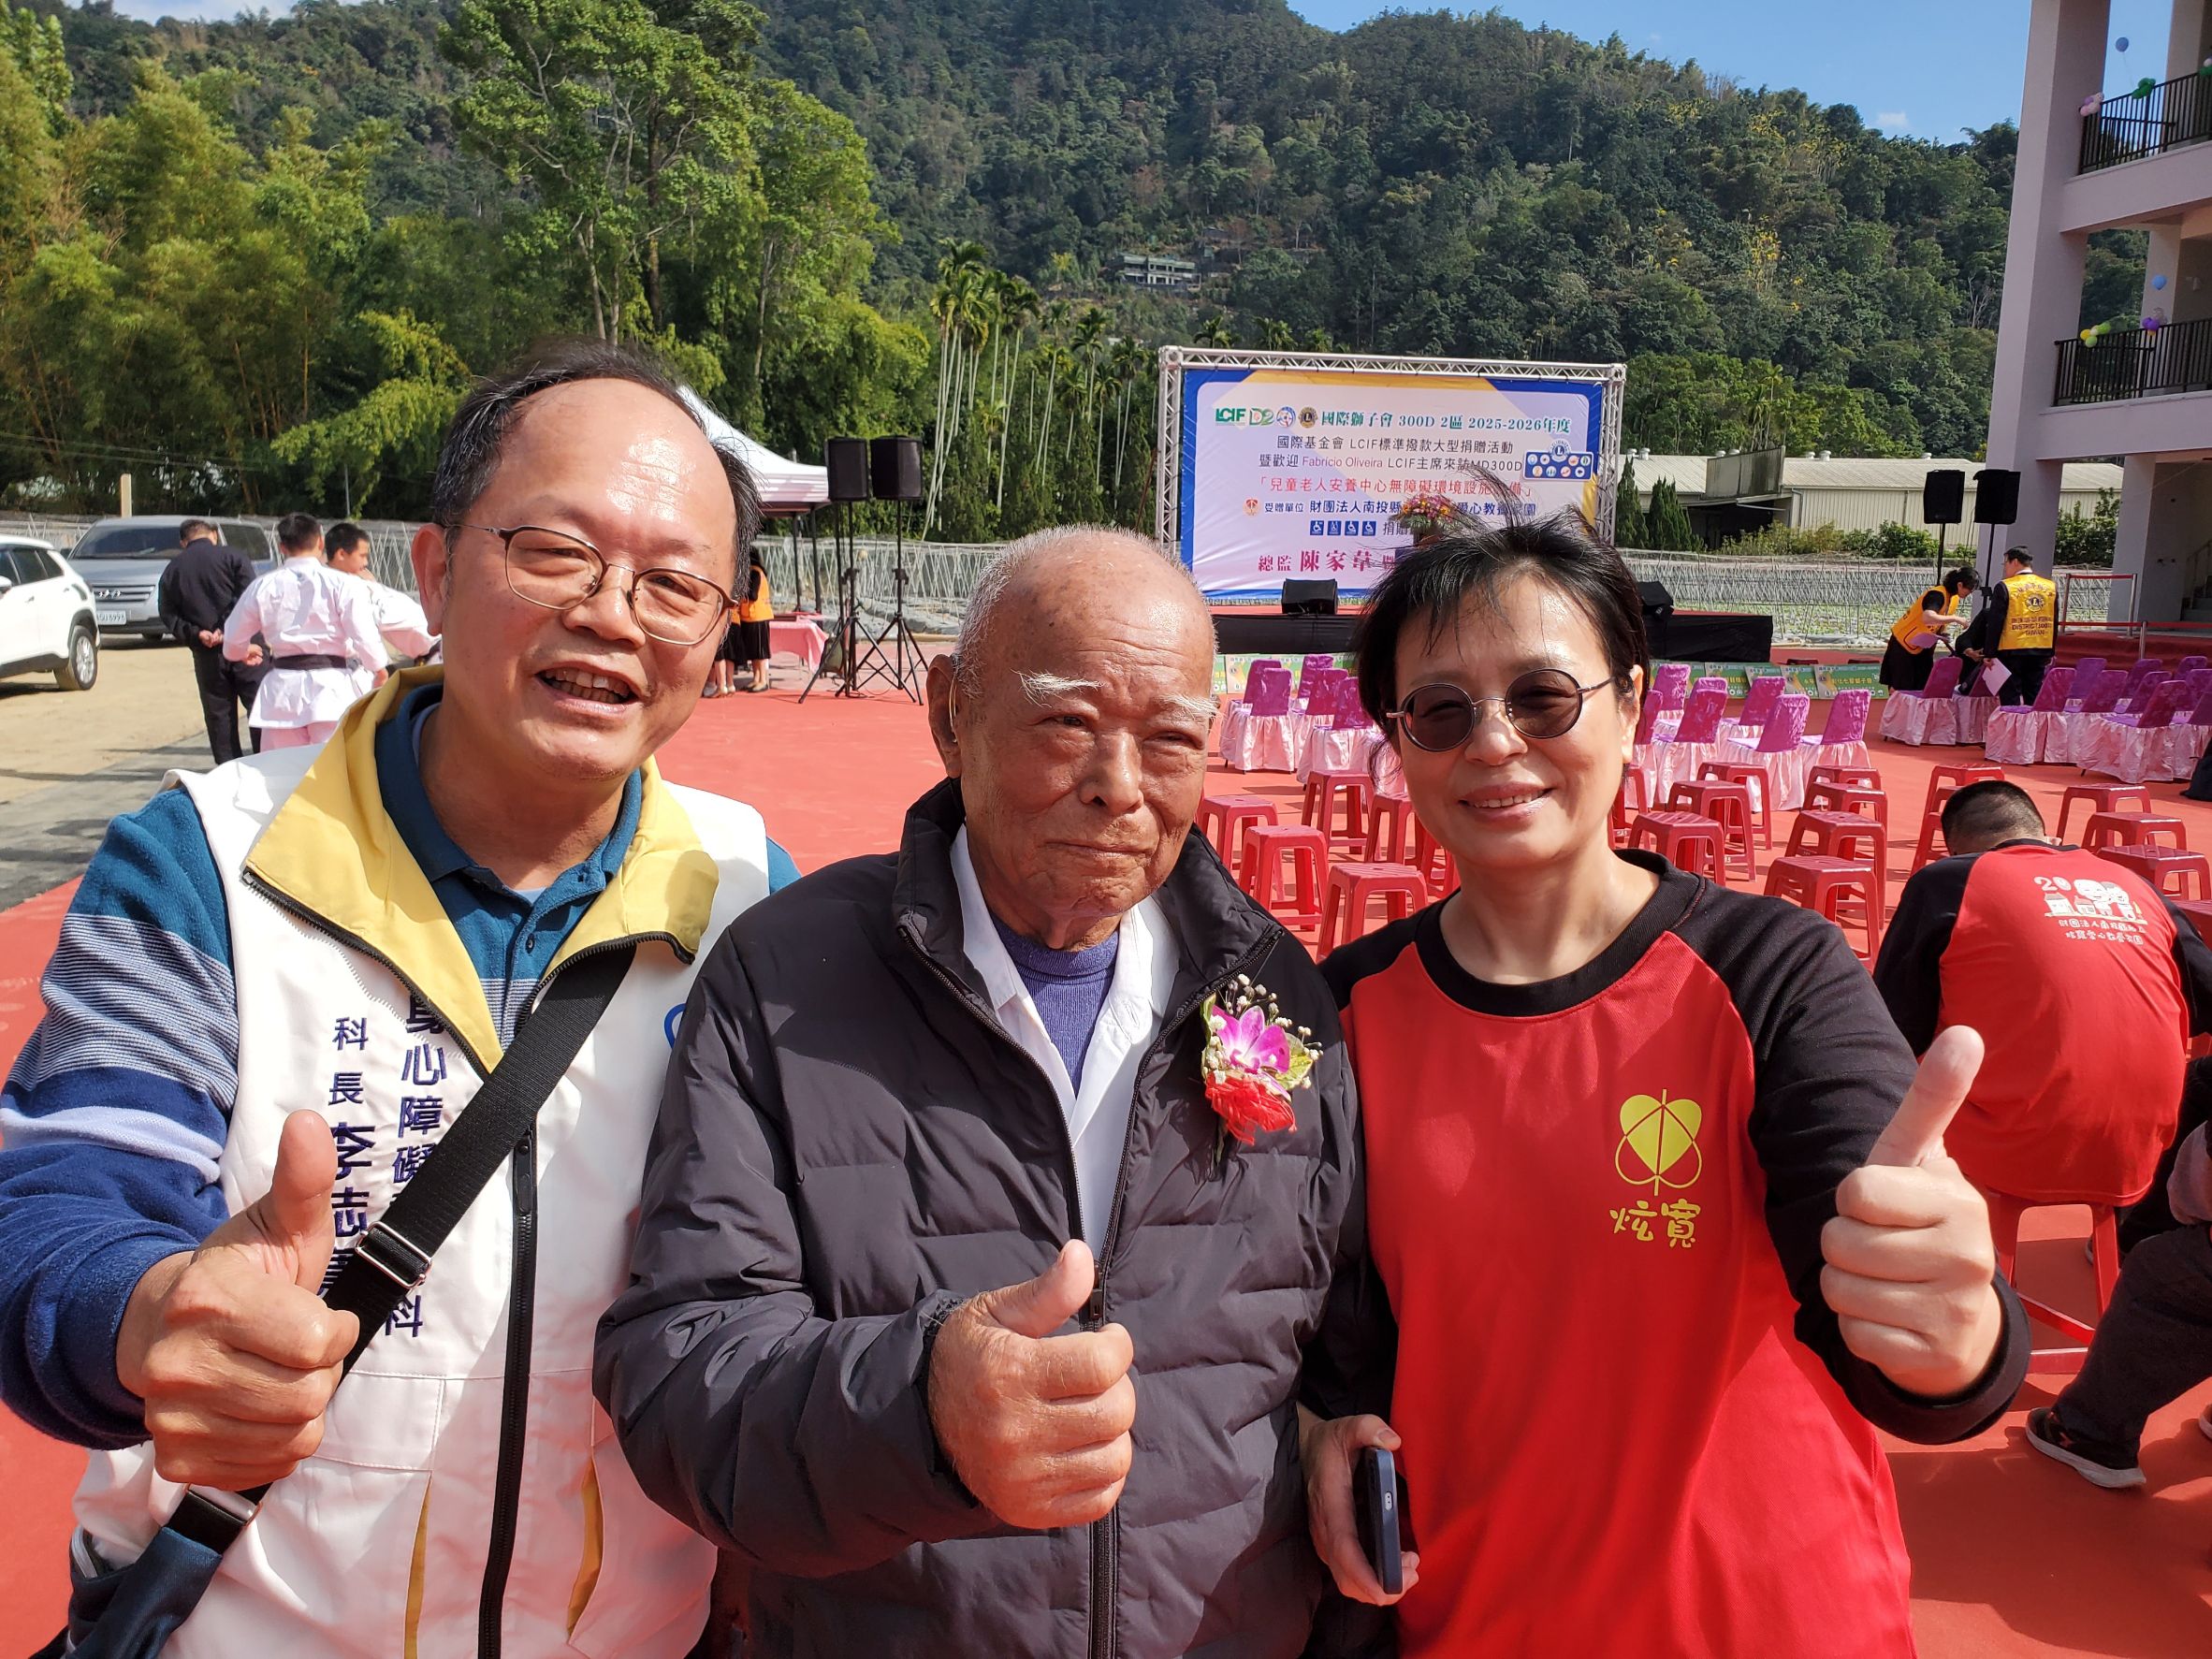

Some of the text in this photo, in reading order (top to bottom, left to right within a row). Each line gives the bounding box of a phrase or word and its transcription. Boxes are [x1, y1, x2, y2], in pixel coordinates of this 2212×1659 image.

[1215, 407, 1246, 422] LCIF
[1399, 415, 1435, 428] 300D
[1441, 415, 1464, 430] 2區
[1468, 416, 1572, 434] 2025-2026年度
[1277, 435, 1513, 454] 國際基金會 LCIF標準撥款大型捐贈活動
[1259, 453, 1299, 468] 暨歡迎
[1346, 456, 1383, 469] Oliveira
[1260, 476, 1532, 497] 「兒童老人安養中心無障礙環境設施備」
[1264, 502, 1304, 514] 受贈單位
[1258, 554, 1292, 572] 總監
[327, 1016, 369, 1106] 科長
